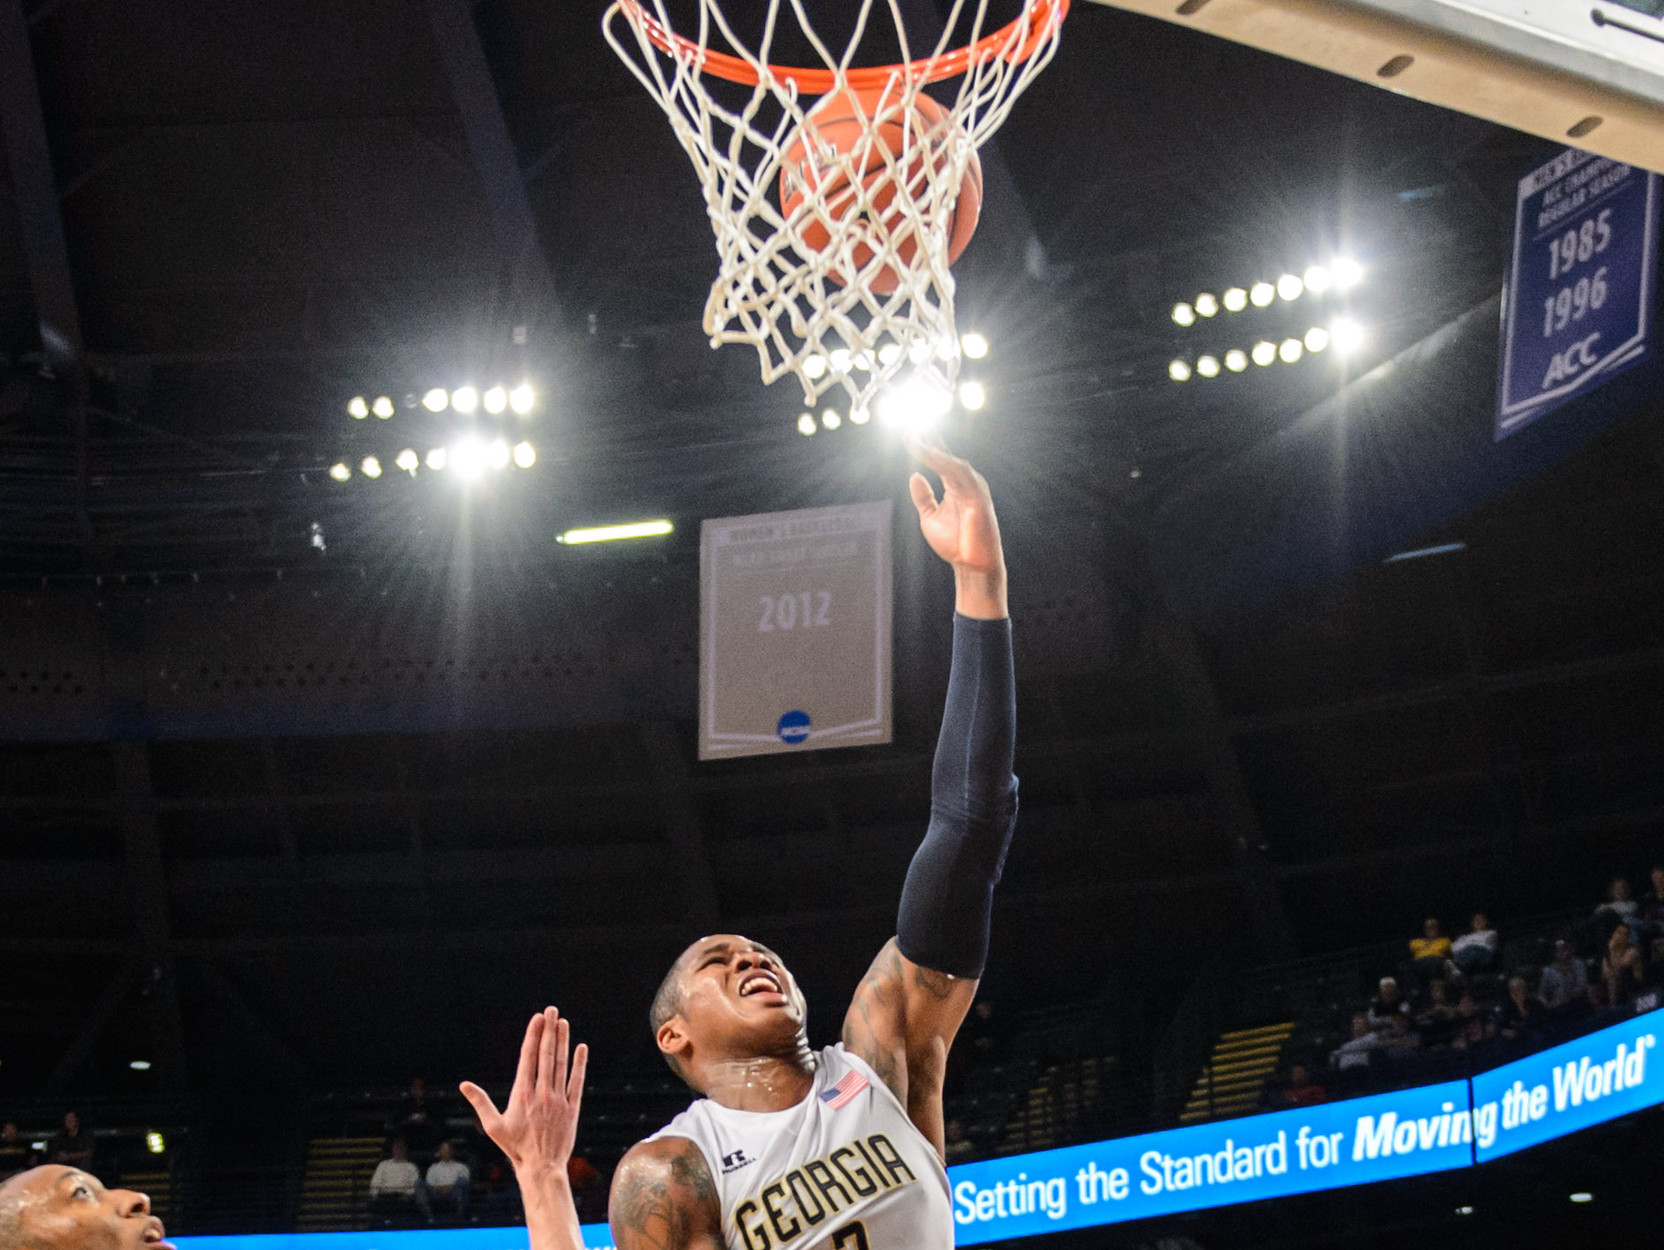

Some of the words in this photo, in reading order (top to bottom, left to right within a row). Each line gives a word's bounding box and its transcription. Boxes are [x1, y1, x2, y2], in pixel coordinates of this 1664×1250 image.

[1549, 208, 1612, 279] 1985
[1543, 266, 1607, 337] 1996
[1542, 333, 1600, 389] ACC
[758, 590, 832, 632] 2012
[954, 1172, 1067, 1225] Setting
[1075, 1161, 1129, 1205] the
[1140, 1130, 1287, 1196] Standard
[1295, 1125, 1344, 1170] for
[1352, 1100, 1498, 1162] Moving
[1502, 1080, 1548, 1130] the
[1552, 1036, 1647, 1113] World
